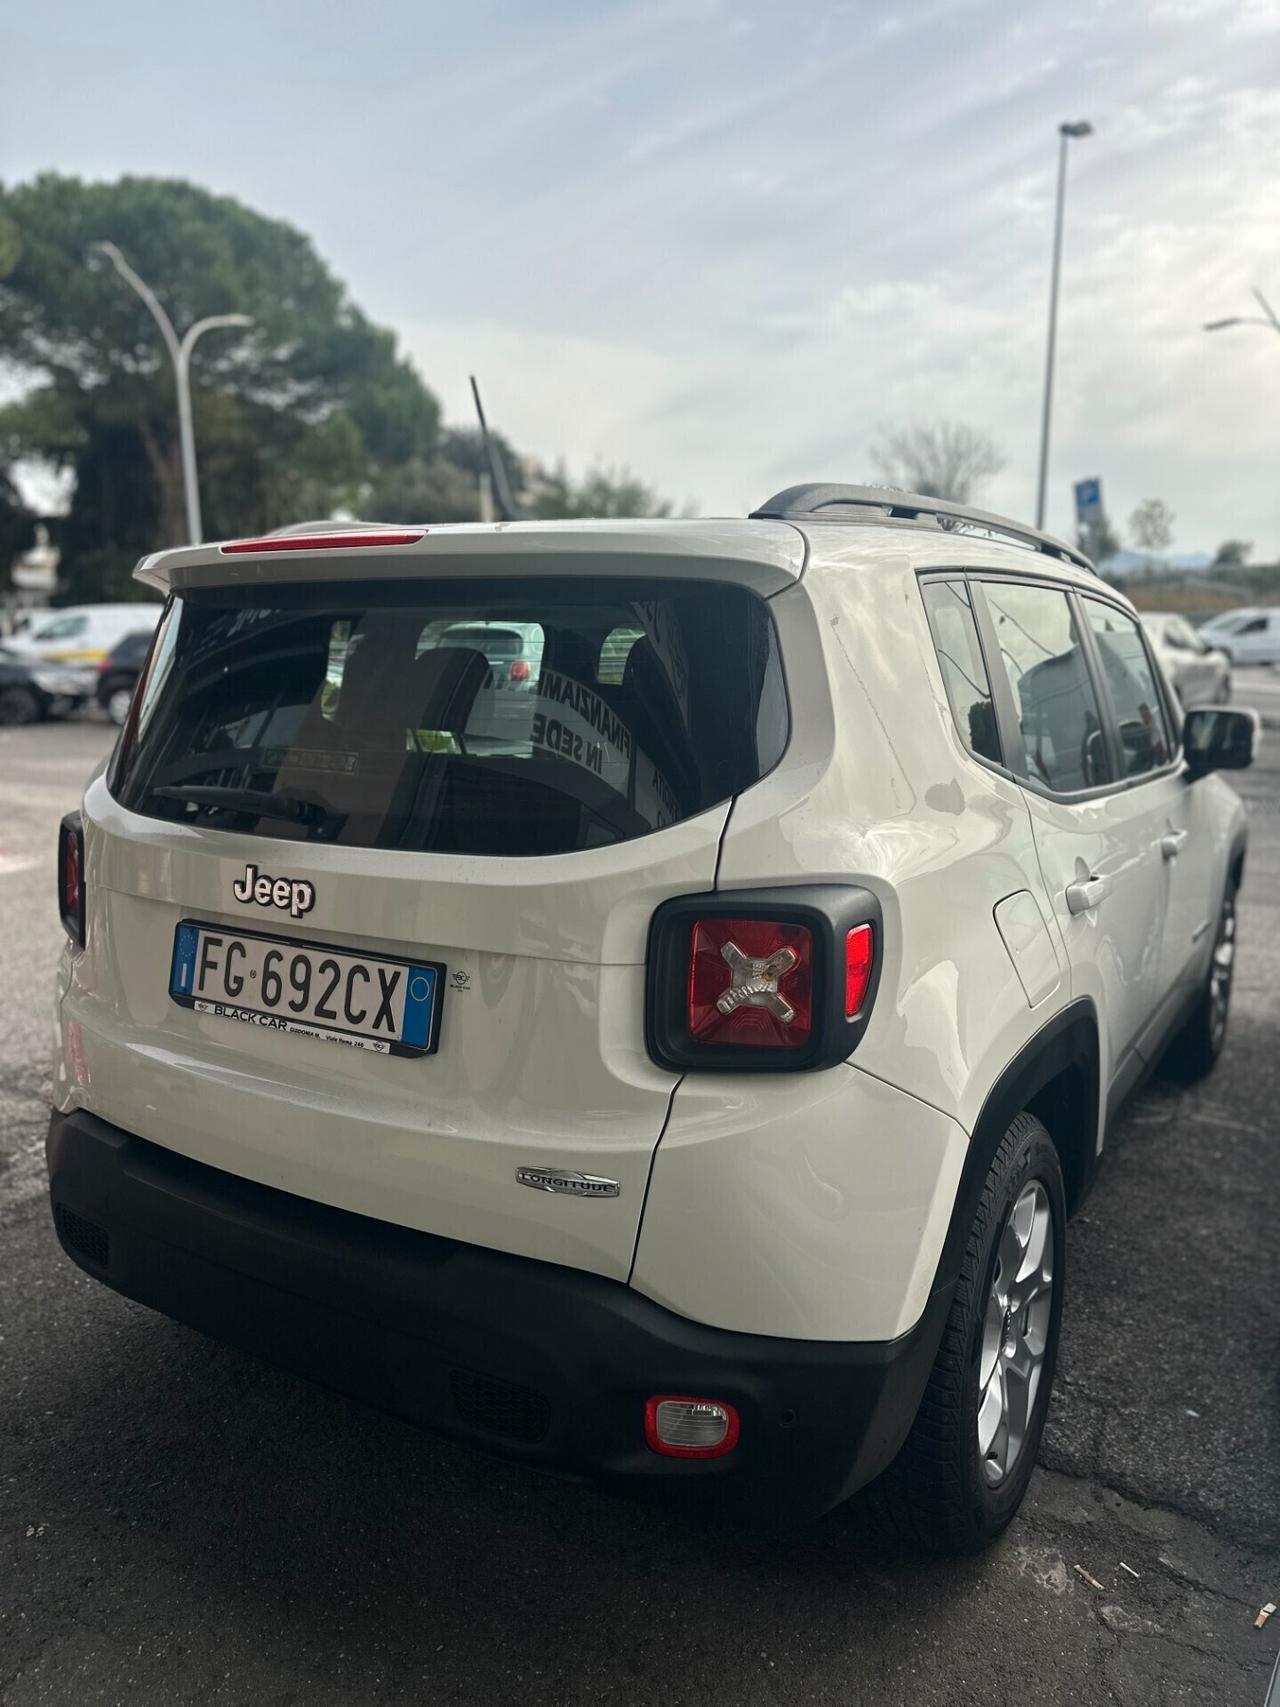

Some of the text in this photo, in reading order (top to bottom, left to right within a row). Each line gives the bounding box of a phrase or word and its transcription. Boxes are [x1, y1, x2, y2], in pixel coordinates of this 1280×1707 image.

[233, 864, 316, 918] Jeep
[198, 936, 401, 1033] FG 692CX
[214, 1004, 257, 1024] BLACK
[260, 1014, 288, 1032] CAR
[520, 1173, 615, 1192] LONGITUDE
